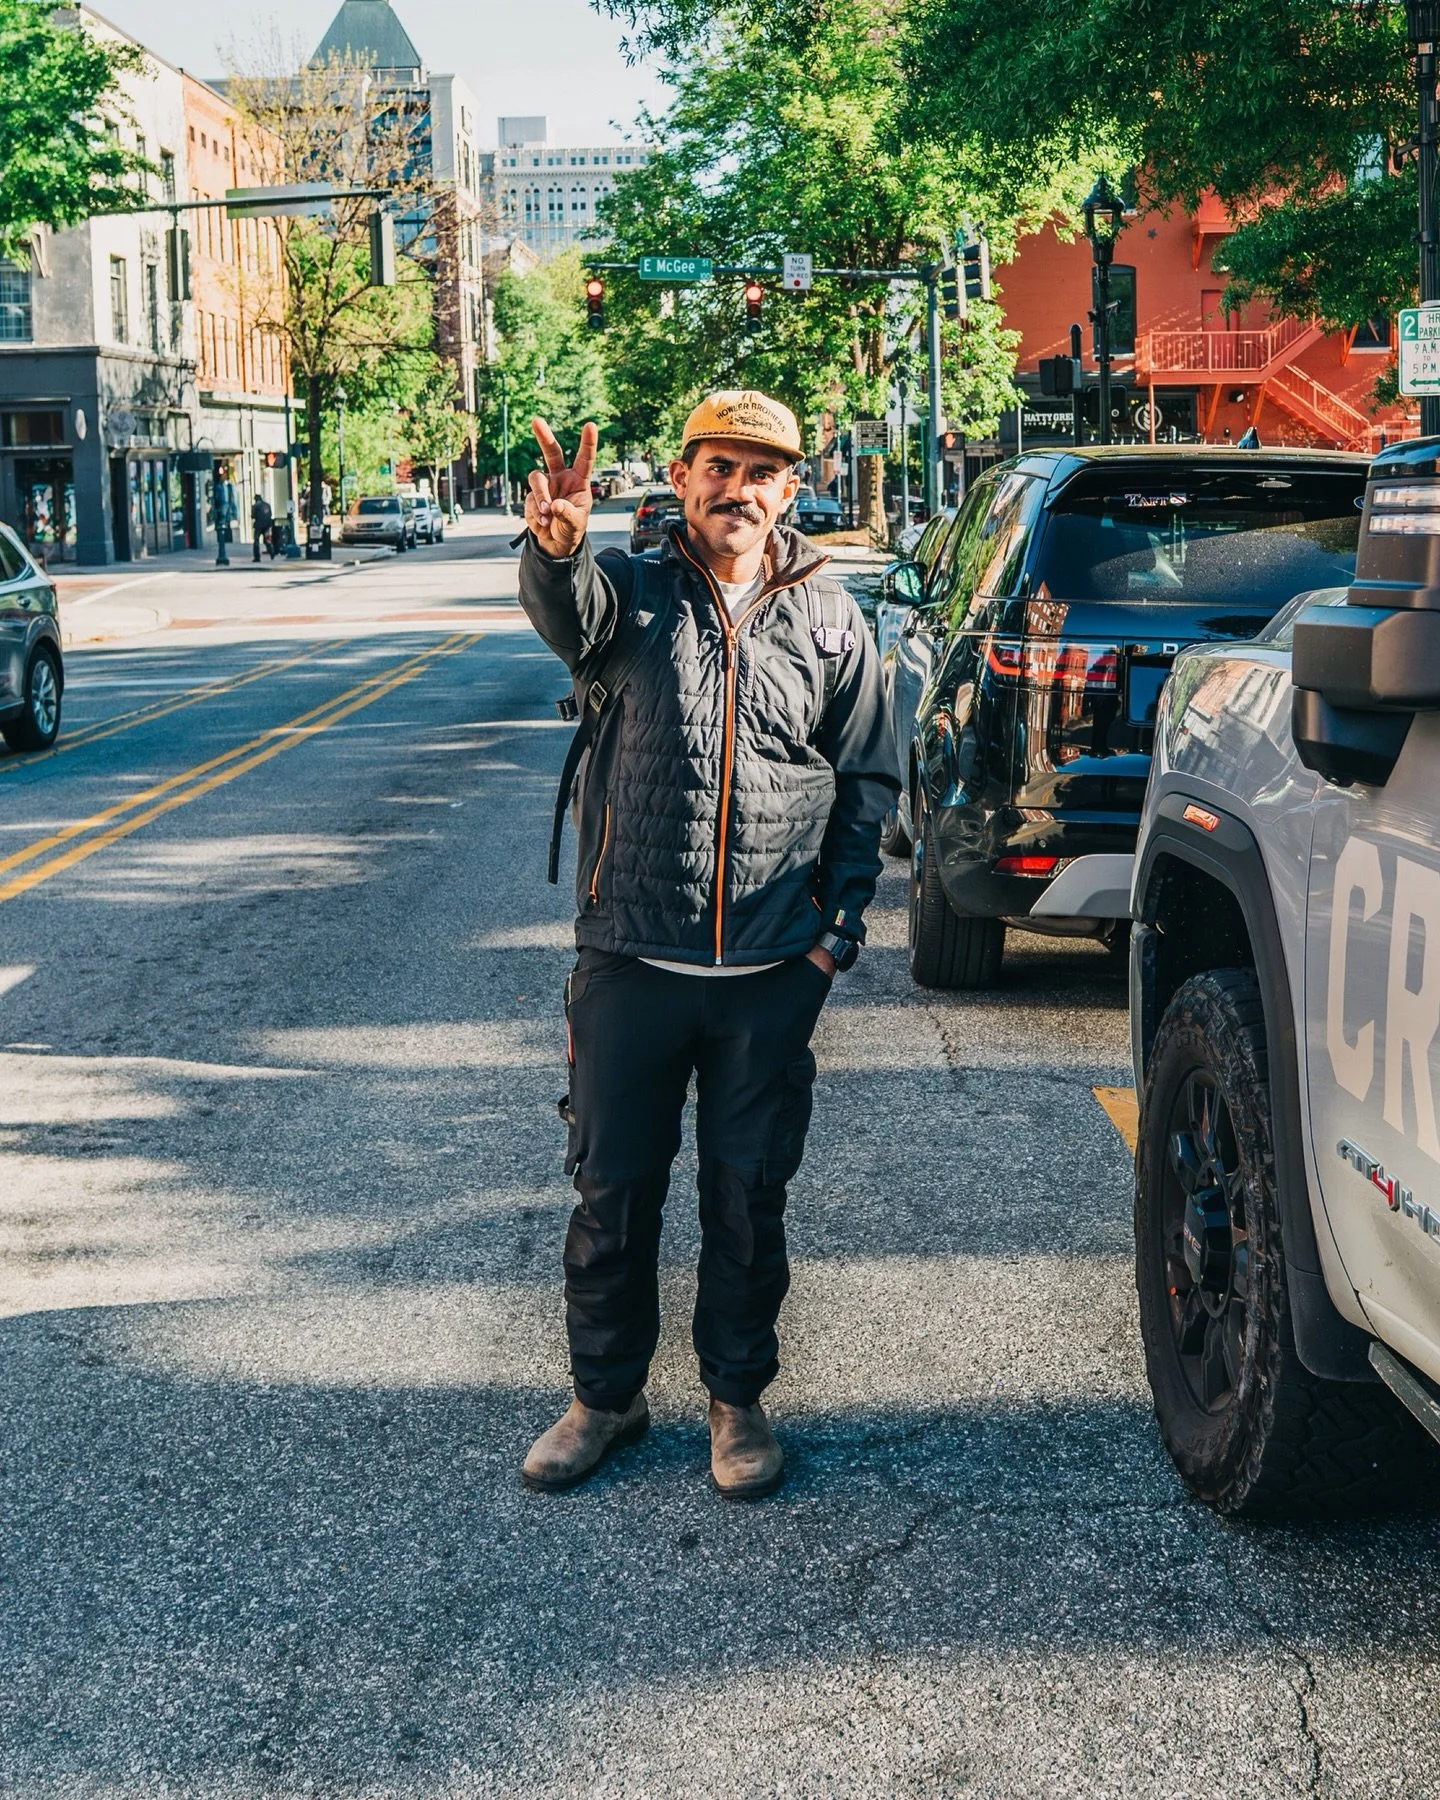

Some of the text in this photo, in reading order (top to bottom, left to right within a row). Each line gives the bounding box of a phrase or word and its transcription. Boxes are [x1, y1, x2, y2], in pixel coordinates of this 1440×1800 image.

[643, 259, 652, 273] E
[656, 259, 696, 274] McGee
[791, 257, 804, 265] NO
[1403, 315, 1416, 337] 2
[1415, 344, 1419, 354] 9
[1413, 363, 1419, 374] 5
[716, 403, 749, 420] HOWLER
[1024, 413, 1052, 421] NATTY
